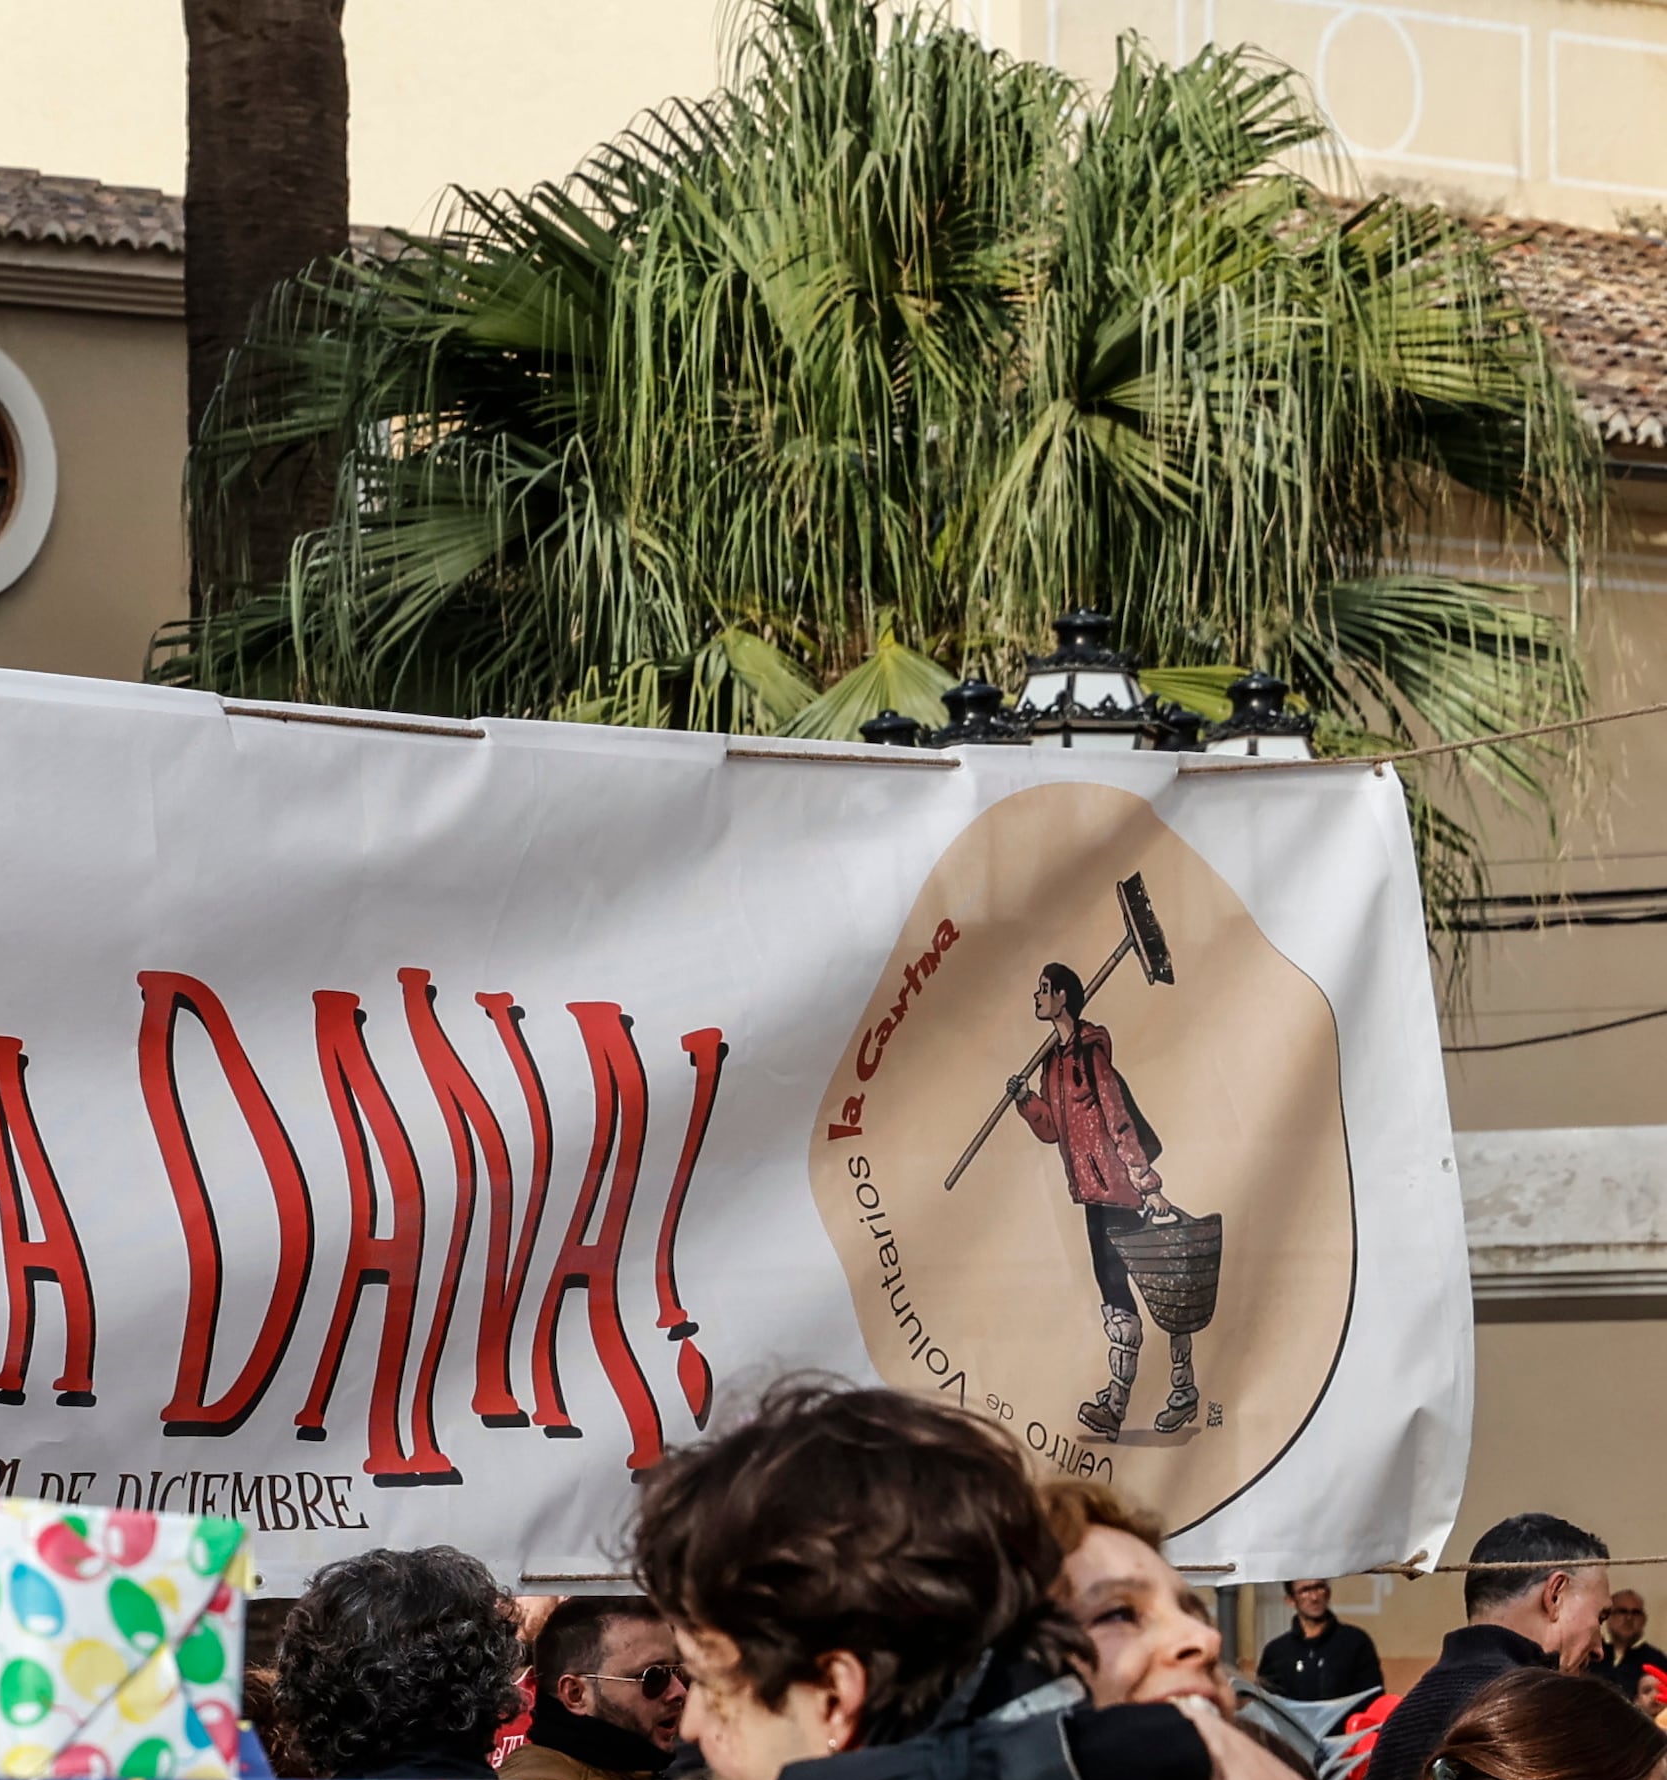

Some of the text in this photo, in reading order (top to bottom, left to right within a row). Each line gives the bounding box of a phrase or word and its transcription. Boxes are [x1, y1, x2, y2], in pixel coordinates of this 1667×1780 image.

[136, 967, 729, 1487] DANA!
[848, 1155, 966, 1408] Voluntarios
[986, 1393, 1014, 1420] de
[116, 1471, 370, 1532] DICIEMBRE
